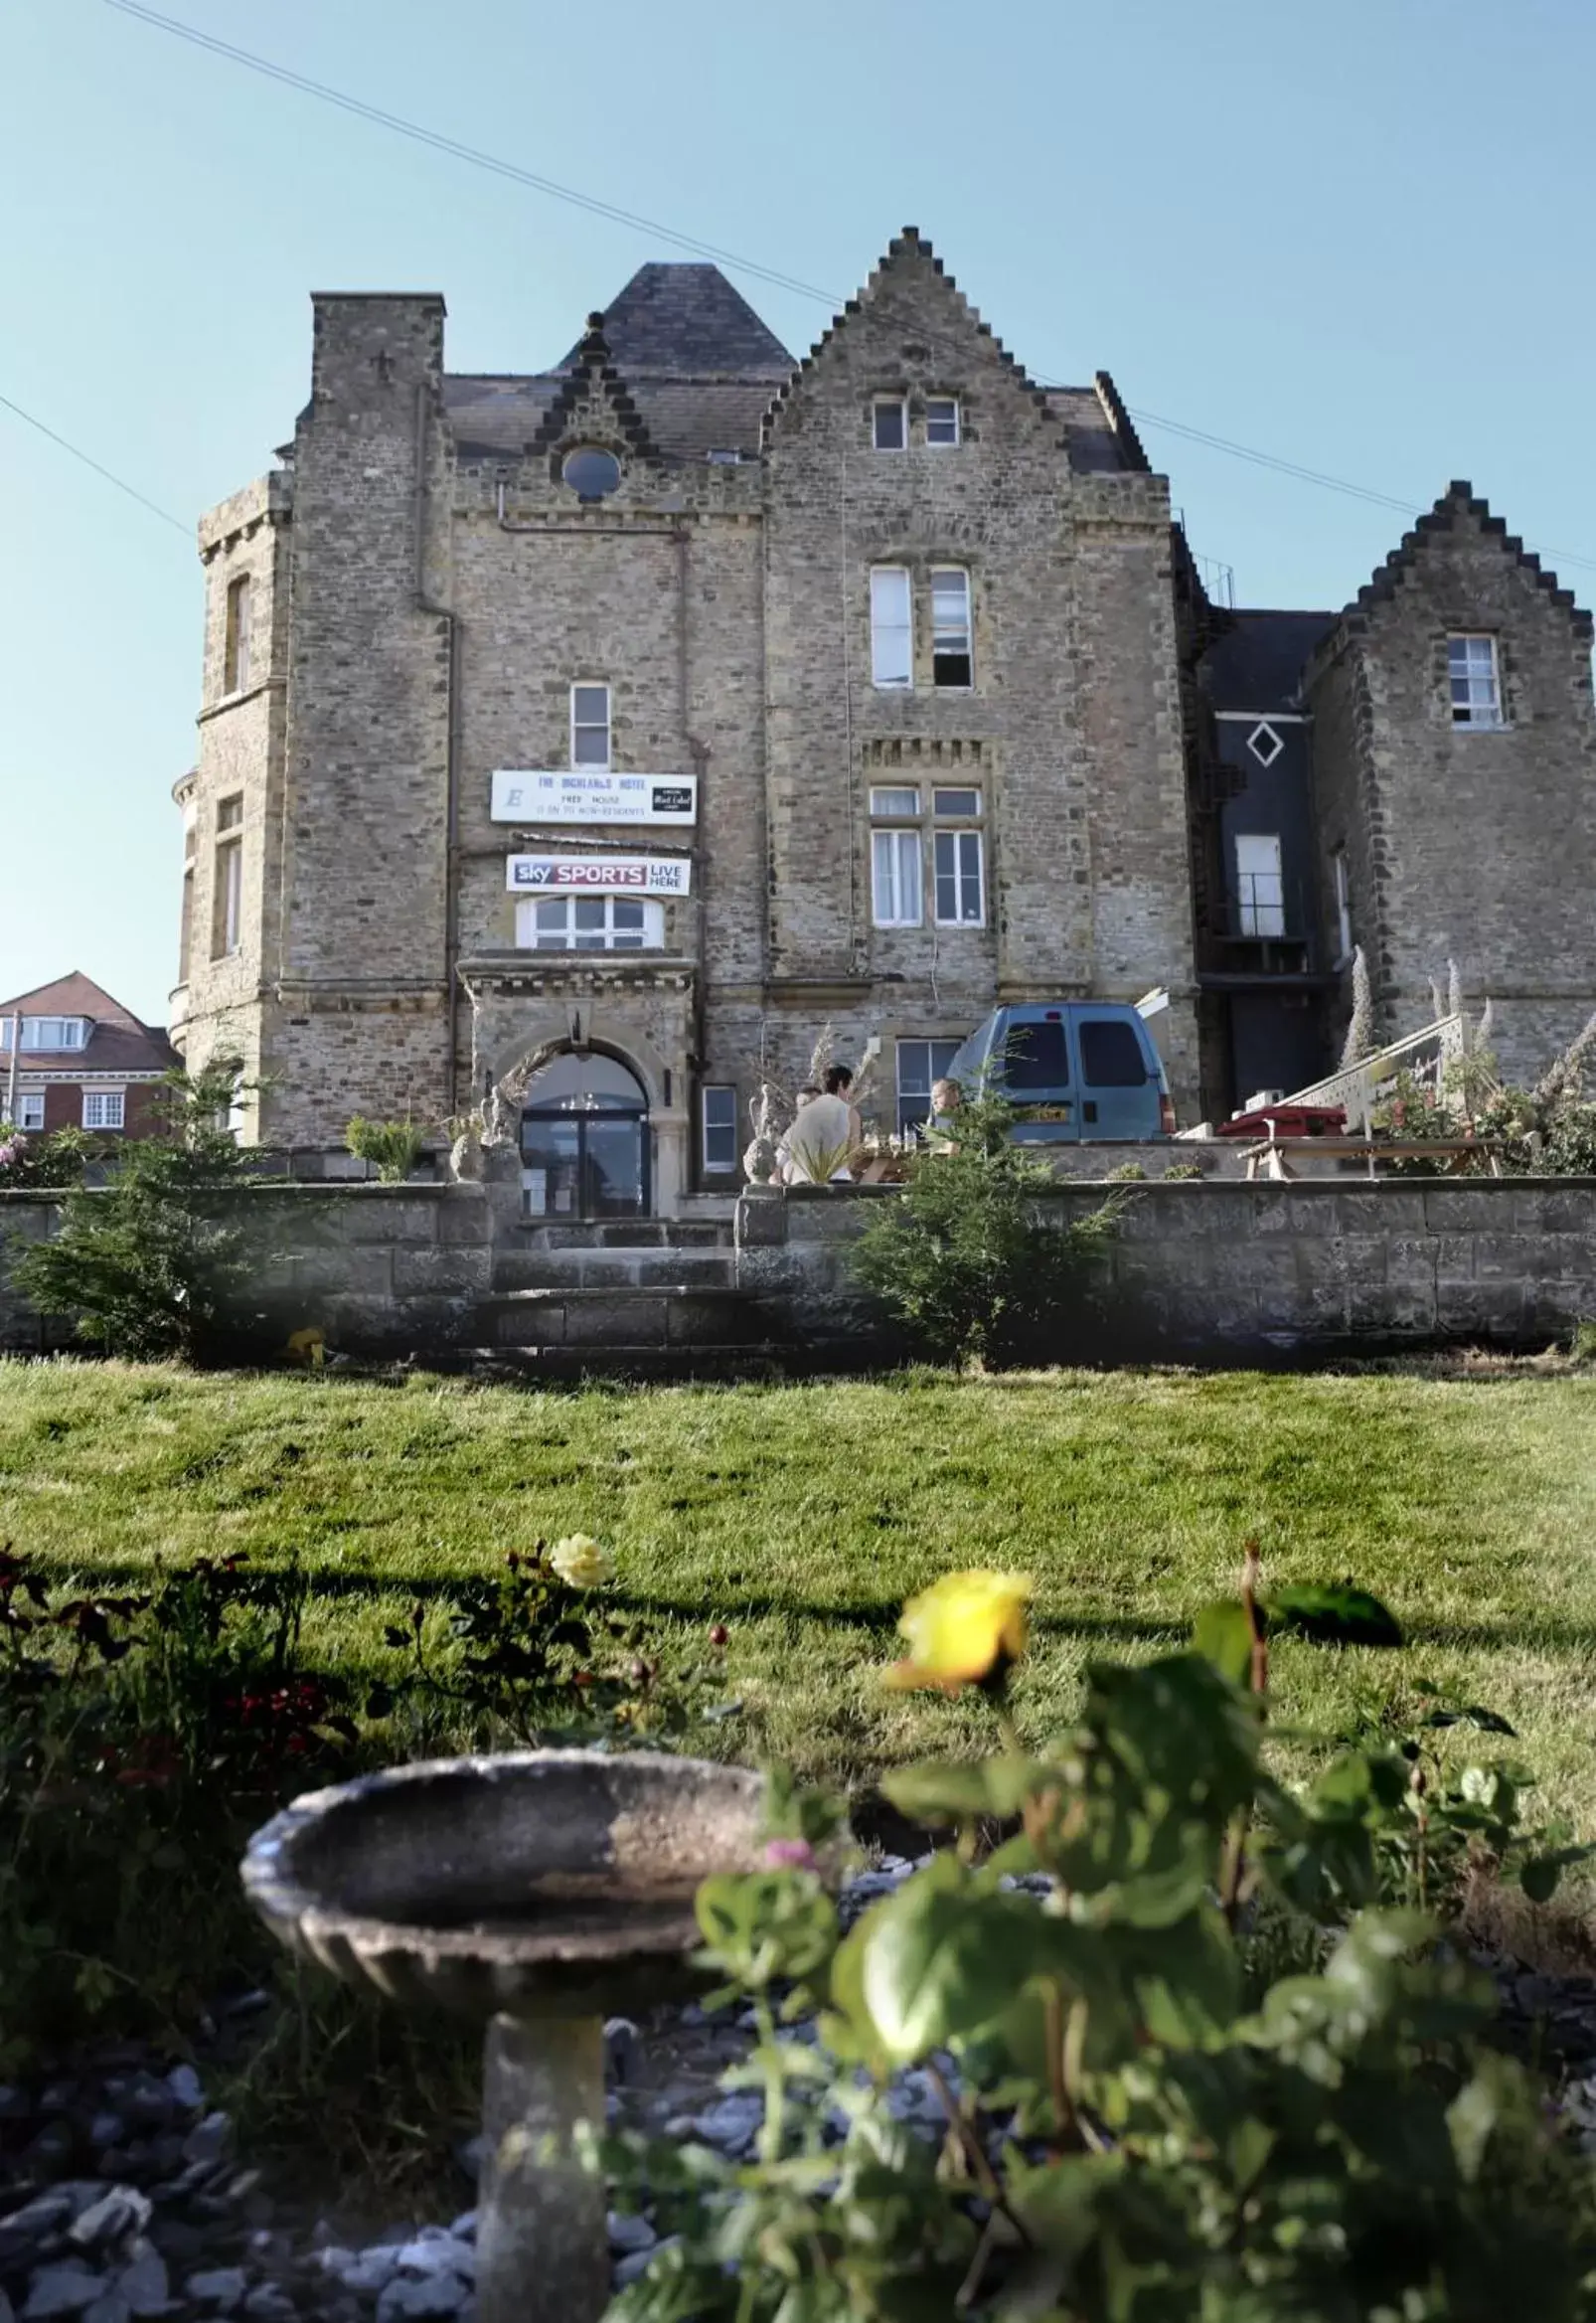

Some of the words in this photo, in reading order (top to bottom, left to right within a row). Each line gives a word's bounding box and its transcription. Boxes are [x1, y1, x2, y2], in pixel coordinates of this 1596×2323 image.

[519, 862, 551, 884] sky
[558, 865, 642, 884] SPORTS
[651, 864, 682, 877] LIVE
[650, 876, 681, 888] HERE
